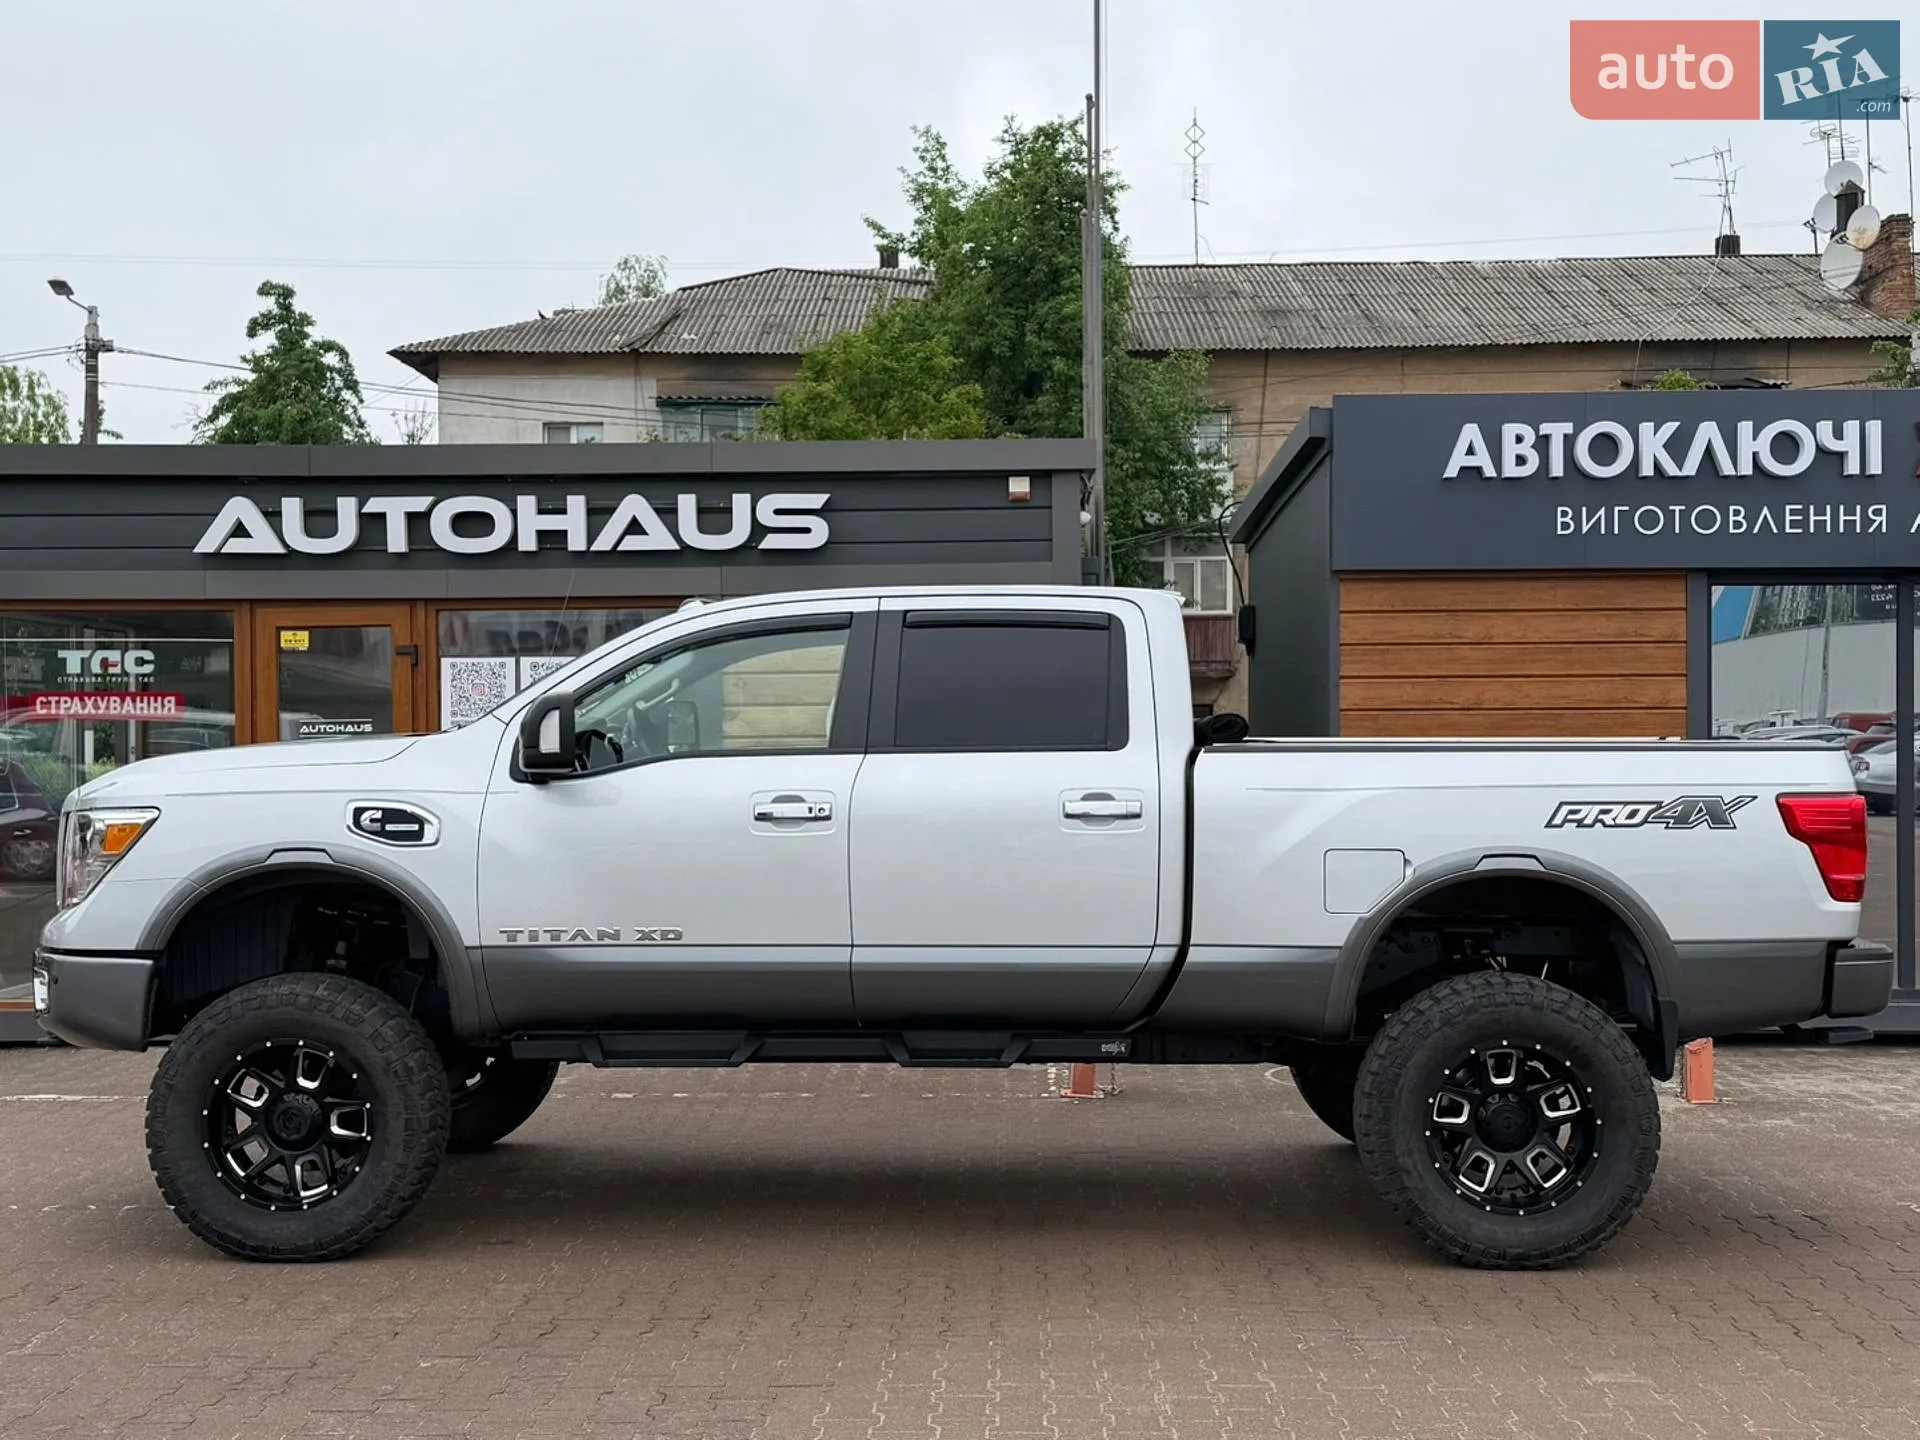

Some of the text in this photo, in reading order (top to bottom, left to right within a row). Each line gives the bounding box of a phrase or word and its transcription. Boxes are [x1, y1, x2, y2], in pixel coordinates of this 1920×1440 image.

[1442, 418, 1883, 479] АВТОКЛЮЧІ
[192, 493, 832, 555] AUTOHAUS
[1556, 504, 1888, 535] ВИГОТОВЛЕННЯ
[35, 696, 176, 715] СТРАХУВАННЯ
[299, 723, 373, 733] AUTOHAUS
[499, 926, 683, 943] TITAN XD
